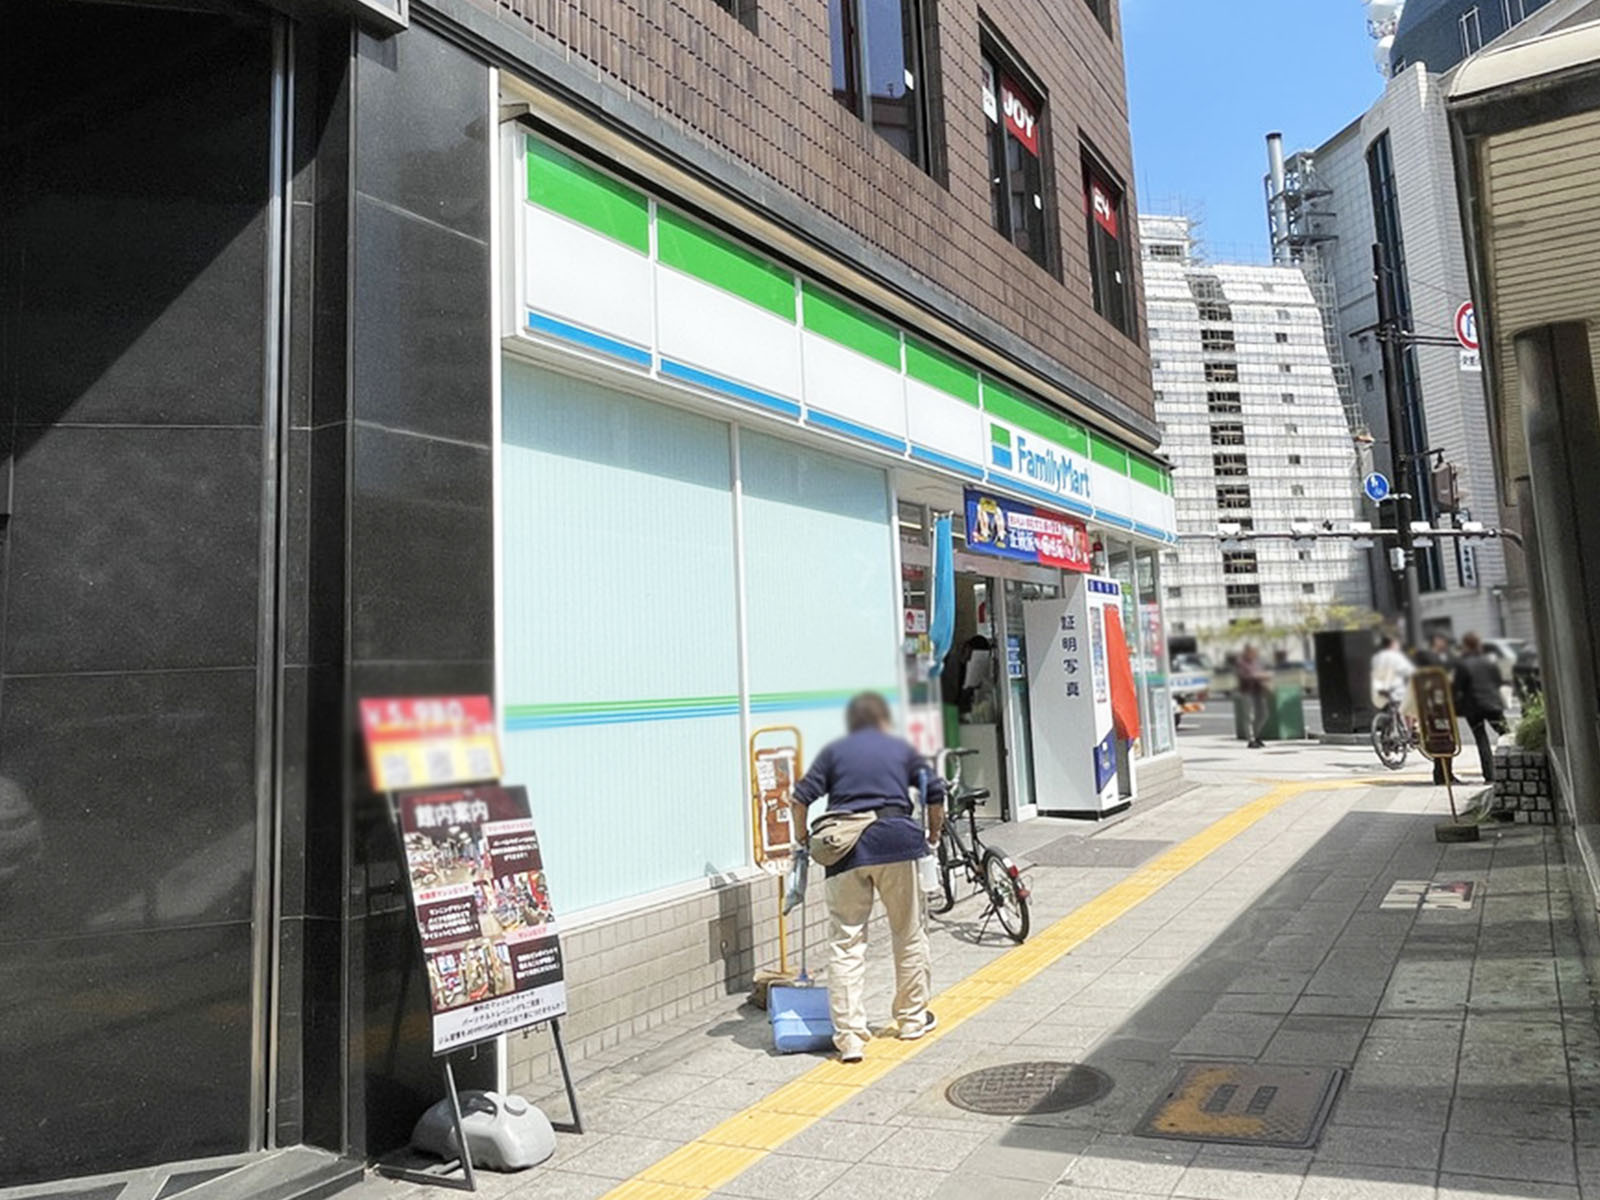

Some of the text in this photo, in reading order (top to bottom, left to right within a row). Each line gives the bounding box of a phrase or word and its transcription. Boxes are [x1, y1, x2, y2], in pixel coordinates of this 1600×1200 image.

[1002, 90, 1035, 138] JOY
[1017, 435, 1090, 498] FamilyMart
[1060, 614, 1080, 697] 証明写真
